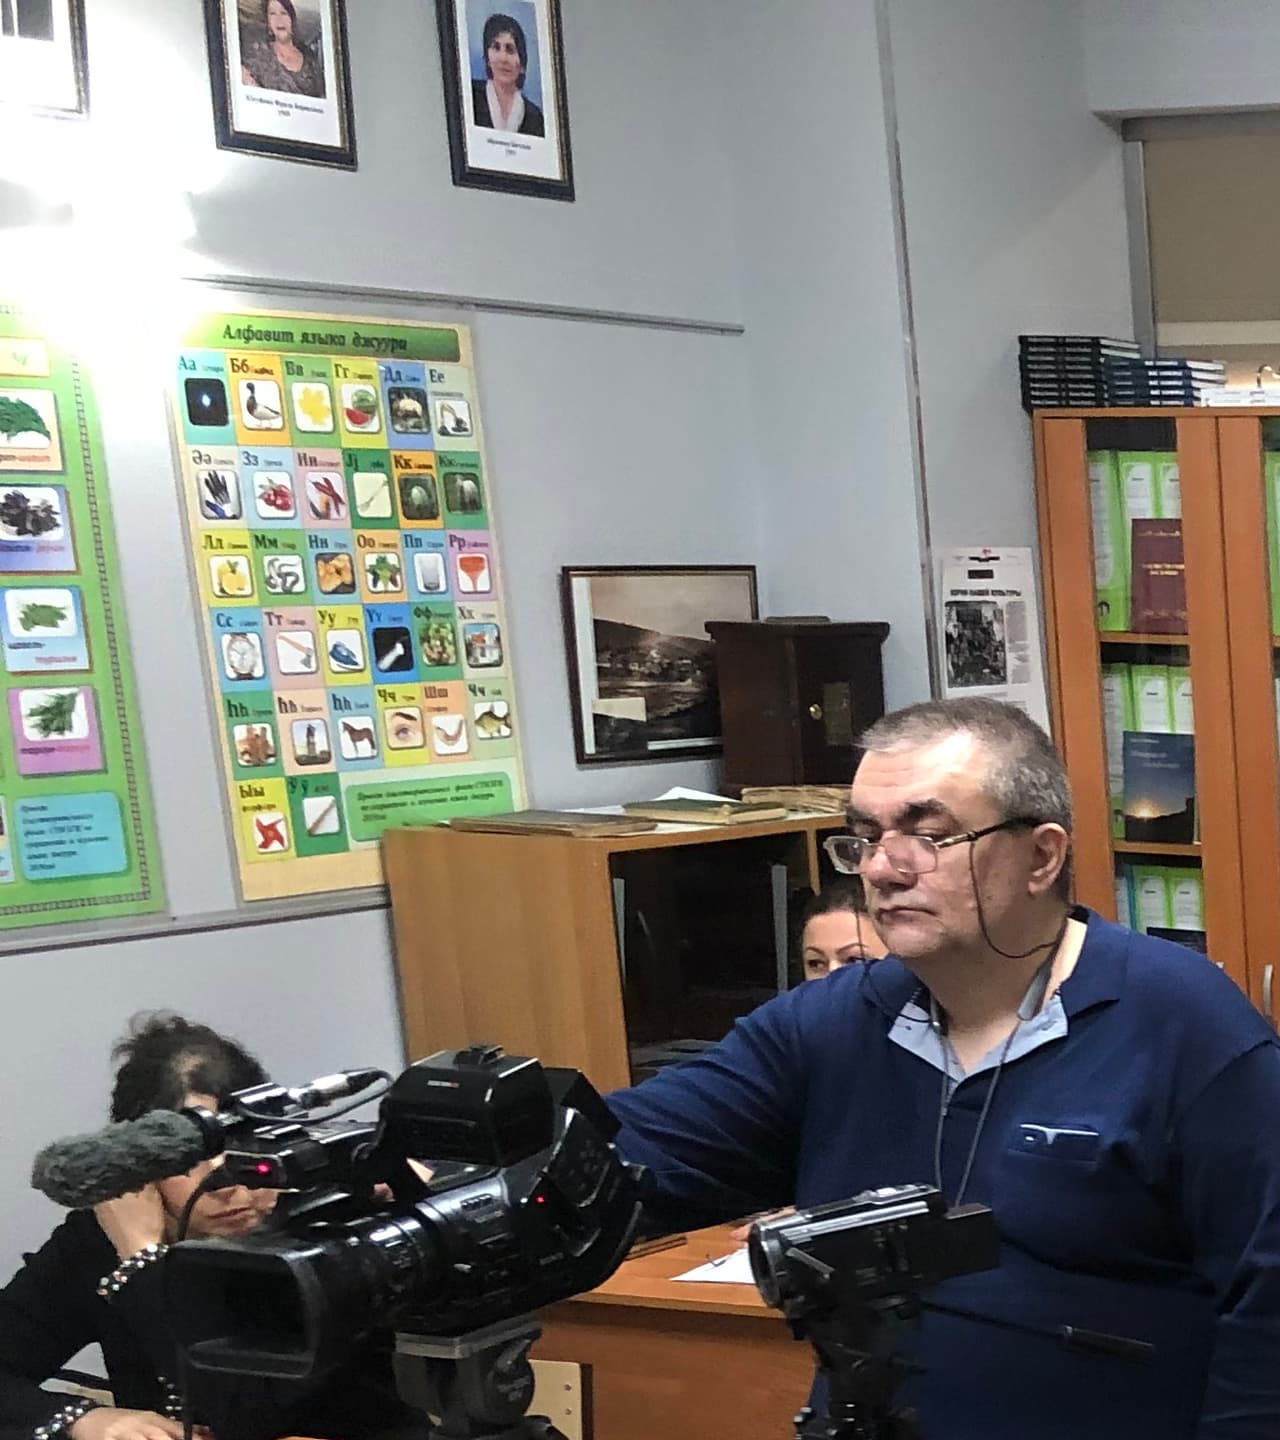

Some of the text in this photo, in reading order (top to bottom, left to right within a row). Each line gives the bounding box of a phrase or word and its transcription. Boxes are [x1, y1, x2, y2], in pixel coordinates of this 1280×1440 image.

[222, 324, 408, 353] Алфавит языка джуури
[230, 358, 249, 374] Бб
[429, 369, 445, 383] Ее
[242, 450, 259, 466] Зз
[203, 535, 224, 549] Лл
[255, 535, 278, 549] Мм
[308, 535, 328, 549] Нн
[357, 535, 375, 549] Оо
[449, 534, 465, 551] Рр
[216, 612, 233, 627] Сс
[265, 611, 282, 627] Тт
